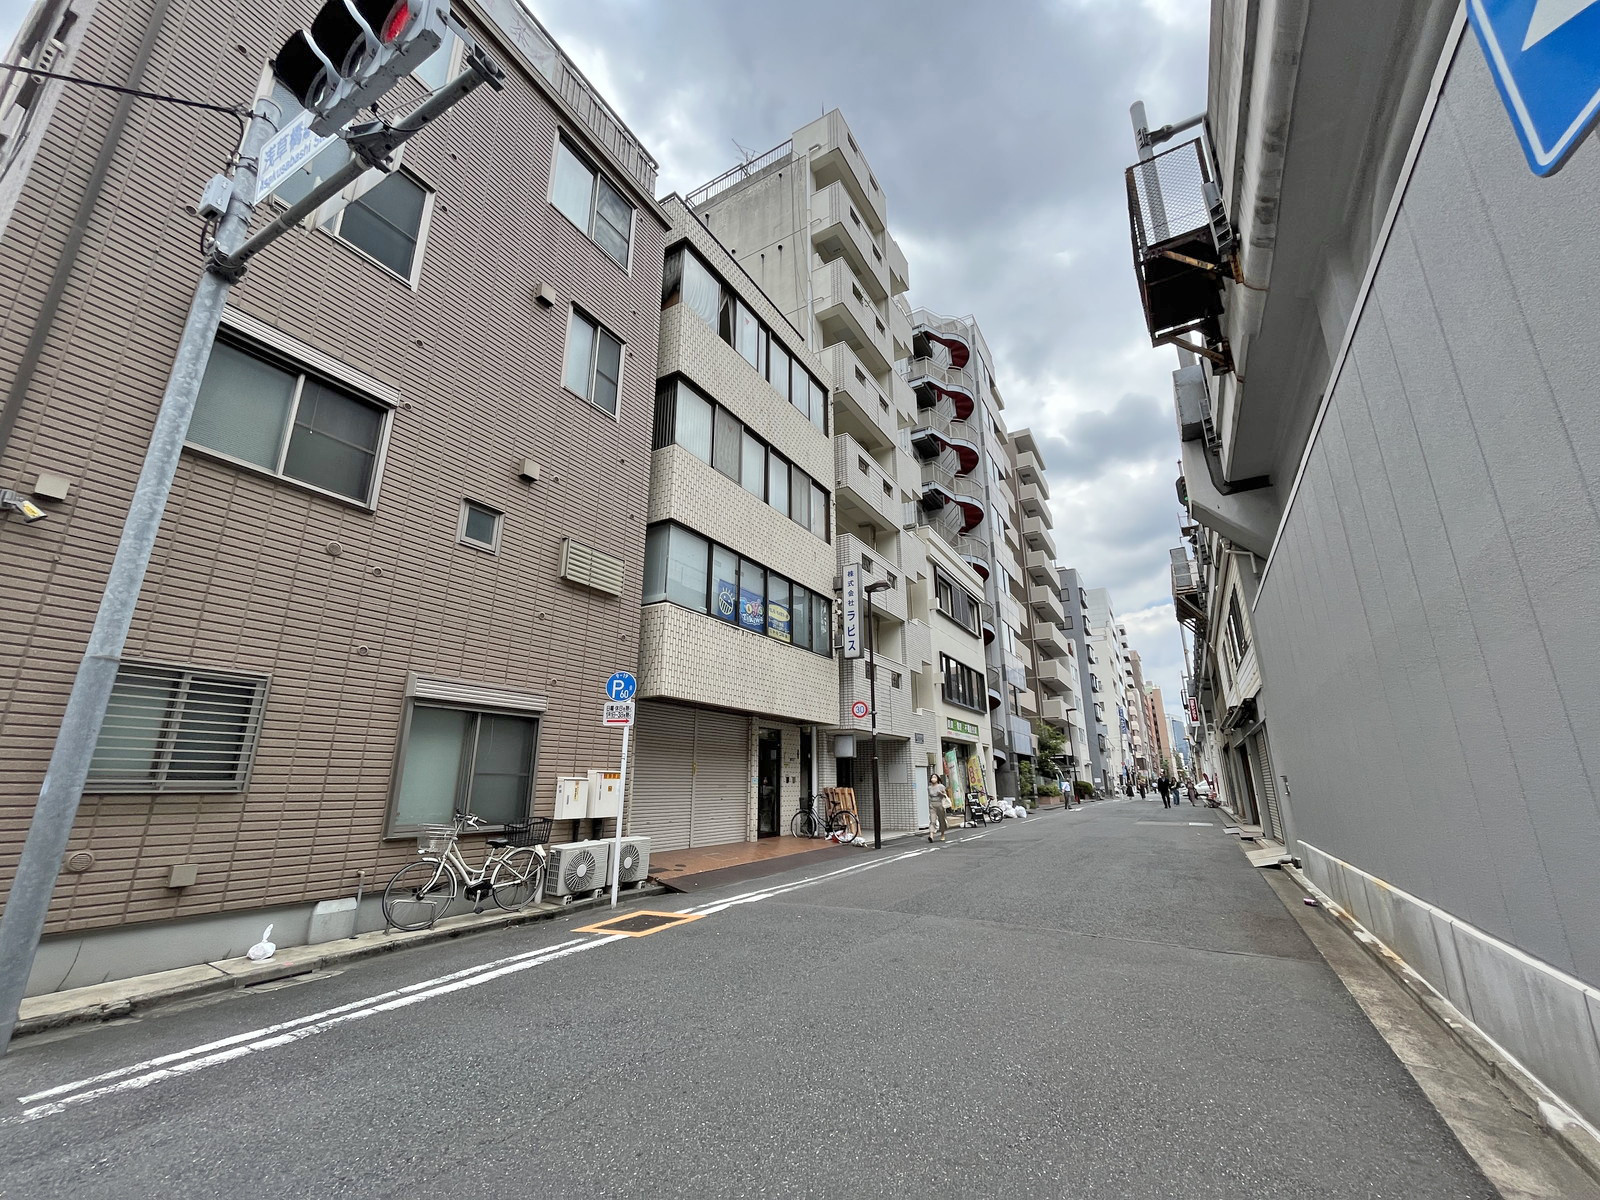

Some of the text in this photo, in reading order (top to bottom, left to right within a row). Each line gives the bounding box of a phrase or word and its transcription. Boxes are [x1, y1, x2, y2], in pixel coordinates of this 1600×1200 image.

[259, 140, 312, 190] Asakusabashi
[612, 680, 624, 698] P
[620, 690, 628, 698] 60
[855, 705, 865, 714] 30
